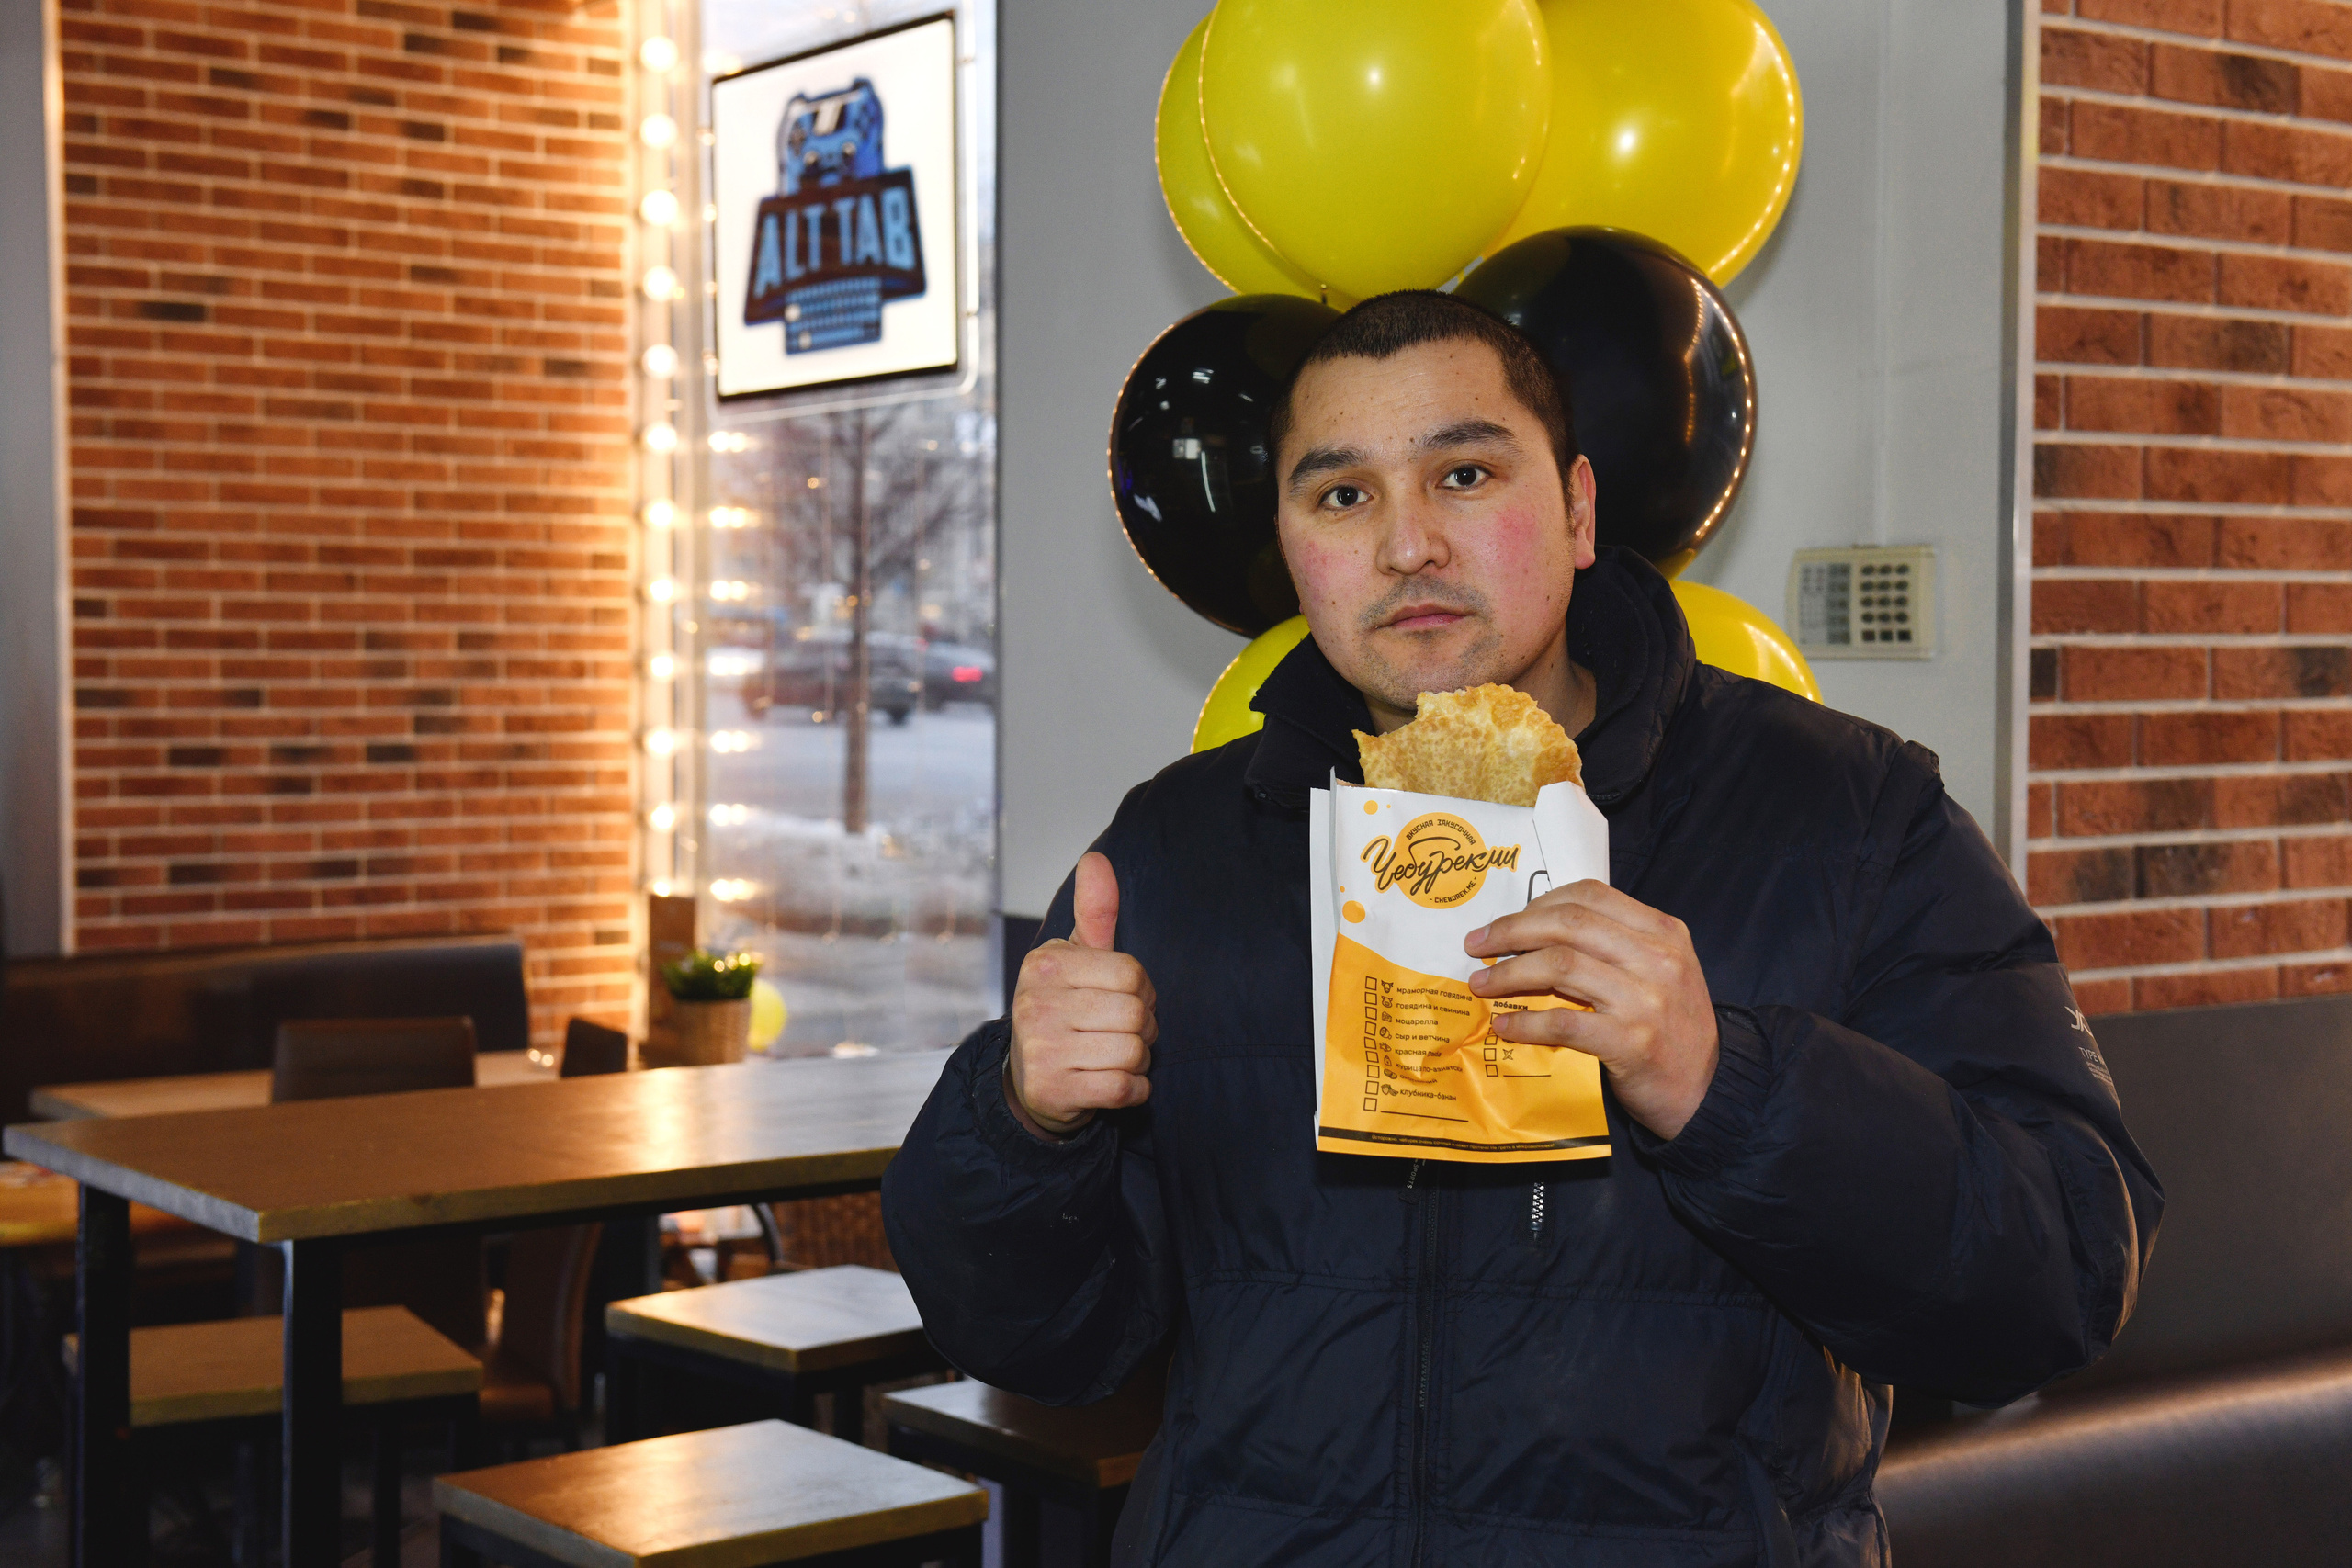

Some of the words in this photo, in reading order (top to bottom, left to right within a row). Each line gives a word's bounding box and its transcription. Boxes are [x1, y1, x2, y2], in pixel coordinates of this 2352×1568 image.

[753, 202, 826, 299] ALT
[832, 186, 916, 271] TAB
[1406, 819, 1434, 840] ВКУСНАЯ
[1437, 818, 1476, 846] ЗАКУСОЧНАЯ
[1439, 990, 1473, 1002] говядина
[1493, 1000, 1529, 1010] добавки
[1439, 1006, 1471, 1017] свинина
[1396, 1018, 1439, 1026] моцарелла
[1395, 1032, 1410, 1041] сыр
[1419, 1034, 1451, 1043] ветчина
[2078, 1046, 2099, 1063] TYPE
[1396, 1063, 1422, 1072] курица
[1399, 1089, 1457, 1101] клубника-банан
[1406, 1163, 1419, 1190] SPORTS
